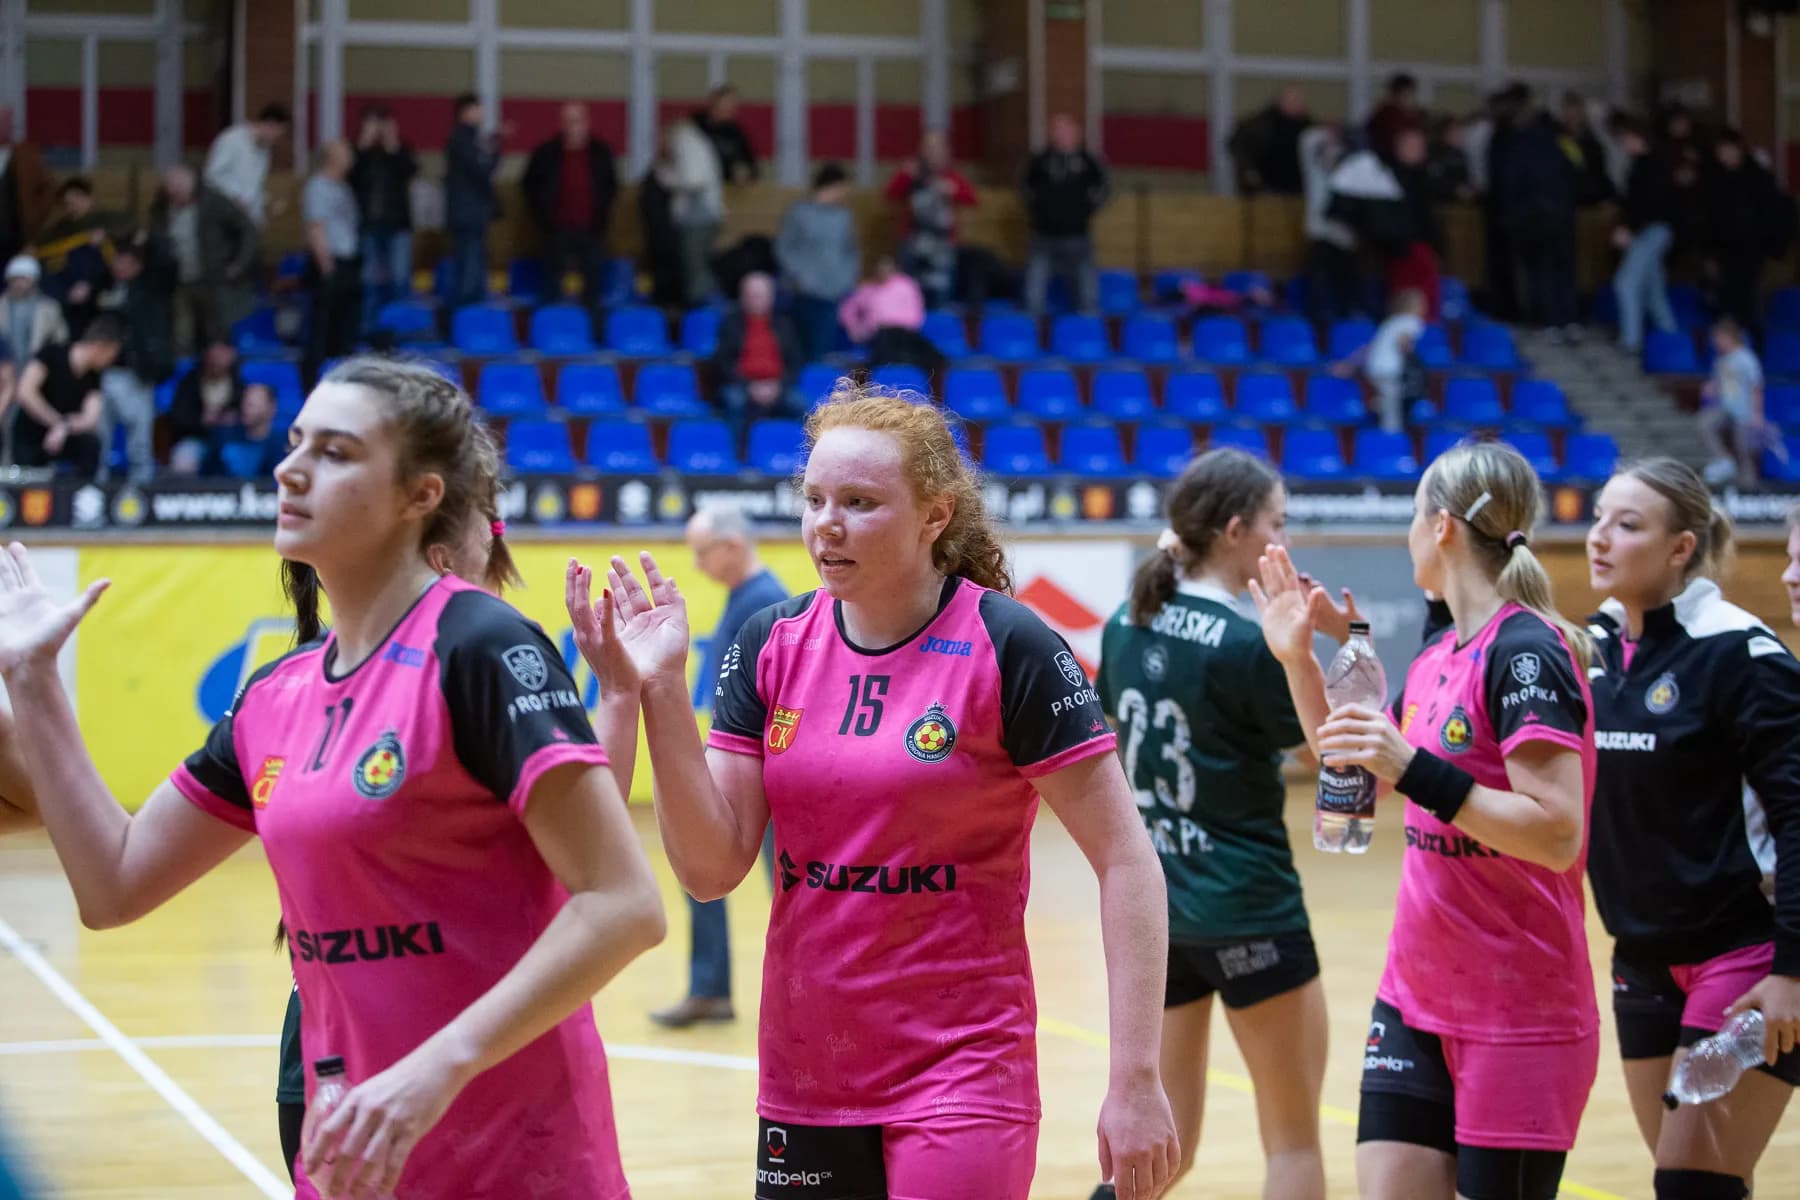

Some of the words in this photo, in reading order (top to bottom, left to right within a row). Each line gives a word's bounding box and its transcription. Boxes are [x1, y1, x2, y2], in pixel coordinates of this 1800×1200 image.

[838, 675, 891, 736] 15
[1502, 685, 1559, 709] PROFIKA
[769, 724, 792, 749] CK
[1118, 688, 1195, 812] 23
[806, 861, 956, 894] SUZUKI
